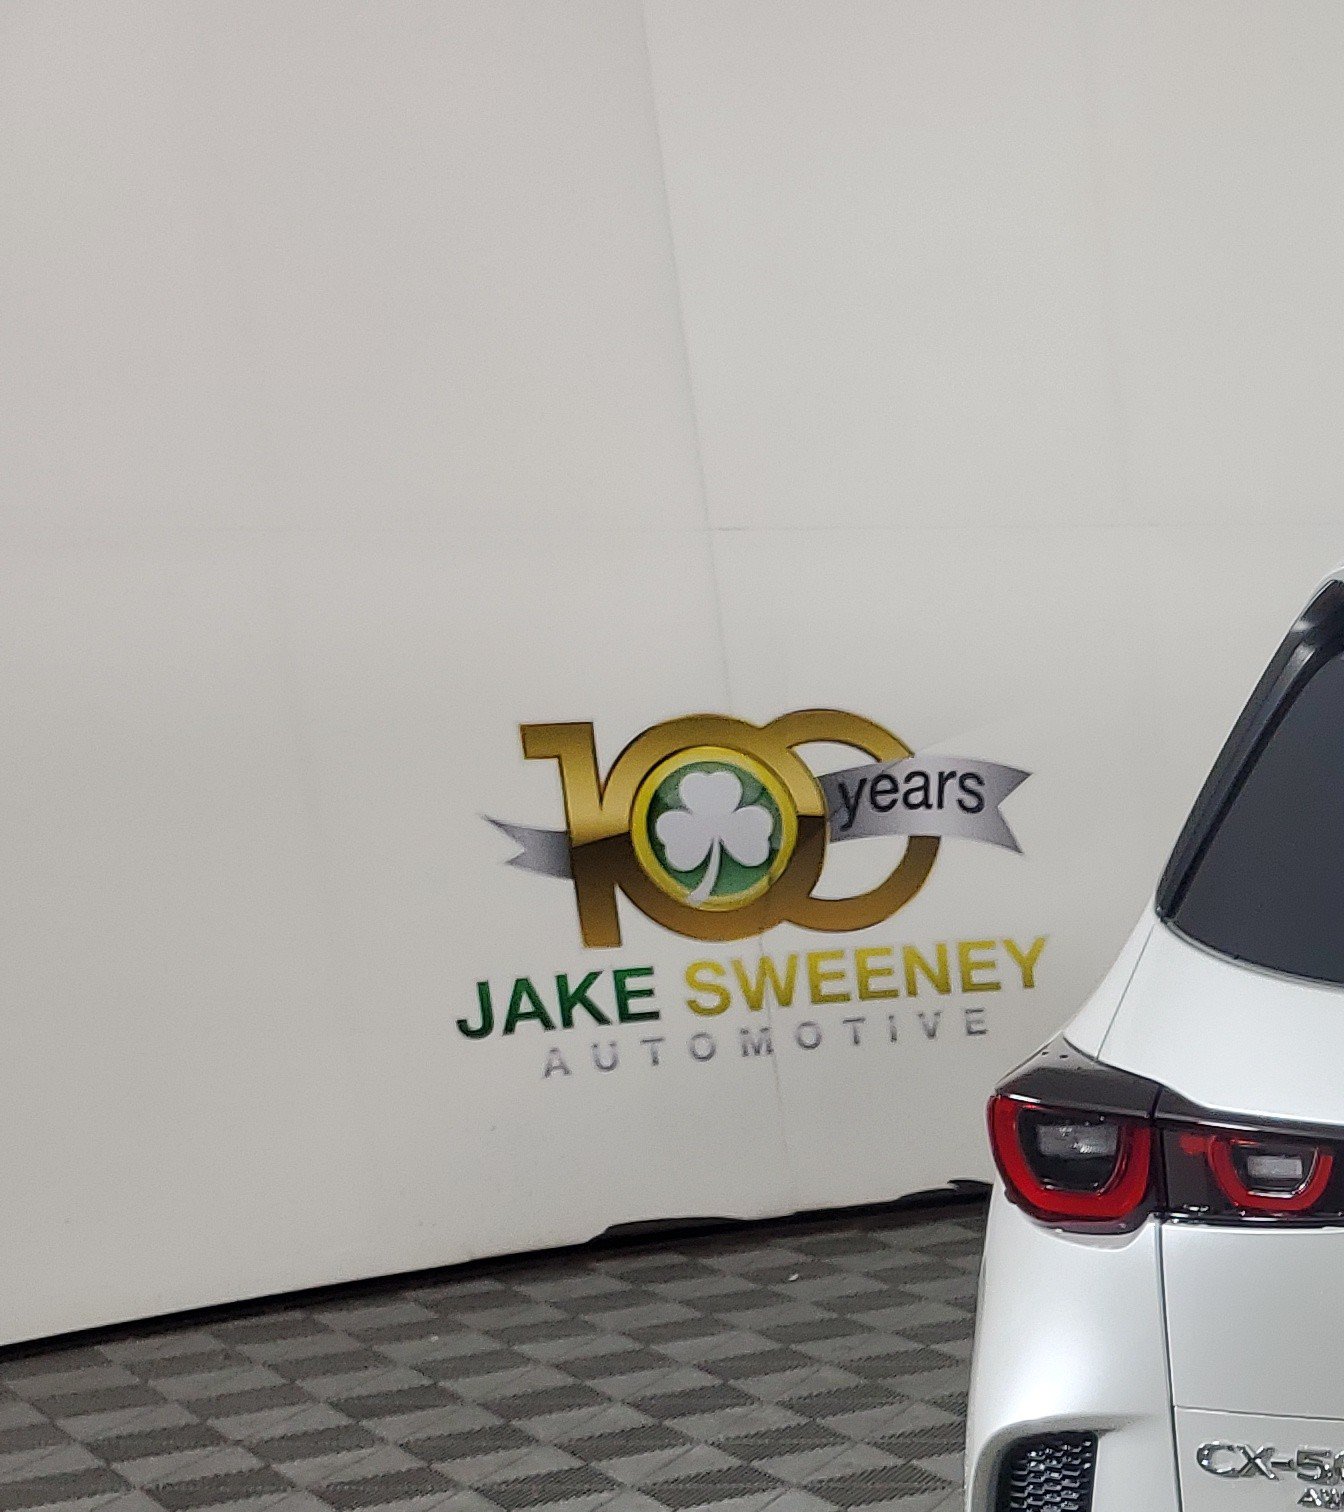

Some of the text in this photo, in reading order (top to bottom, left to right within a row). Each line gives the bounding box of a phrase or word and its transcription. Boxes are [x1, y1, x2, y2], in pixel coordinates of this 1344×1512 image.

[837, 765, 986, 831] years
[456, 935, 1050, 1040] JAKE SWEENEY
[543, 1007, 991, 1078] AUTOMOTIVE
